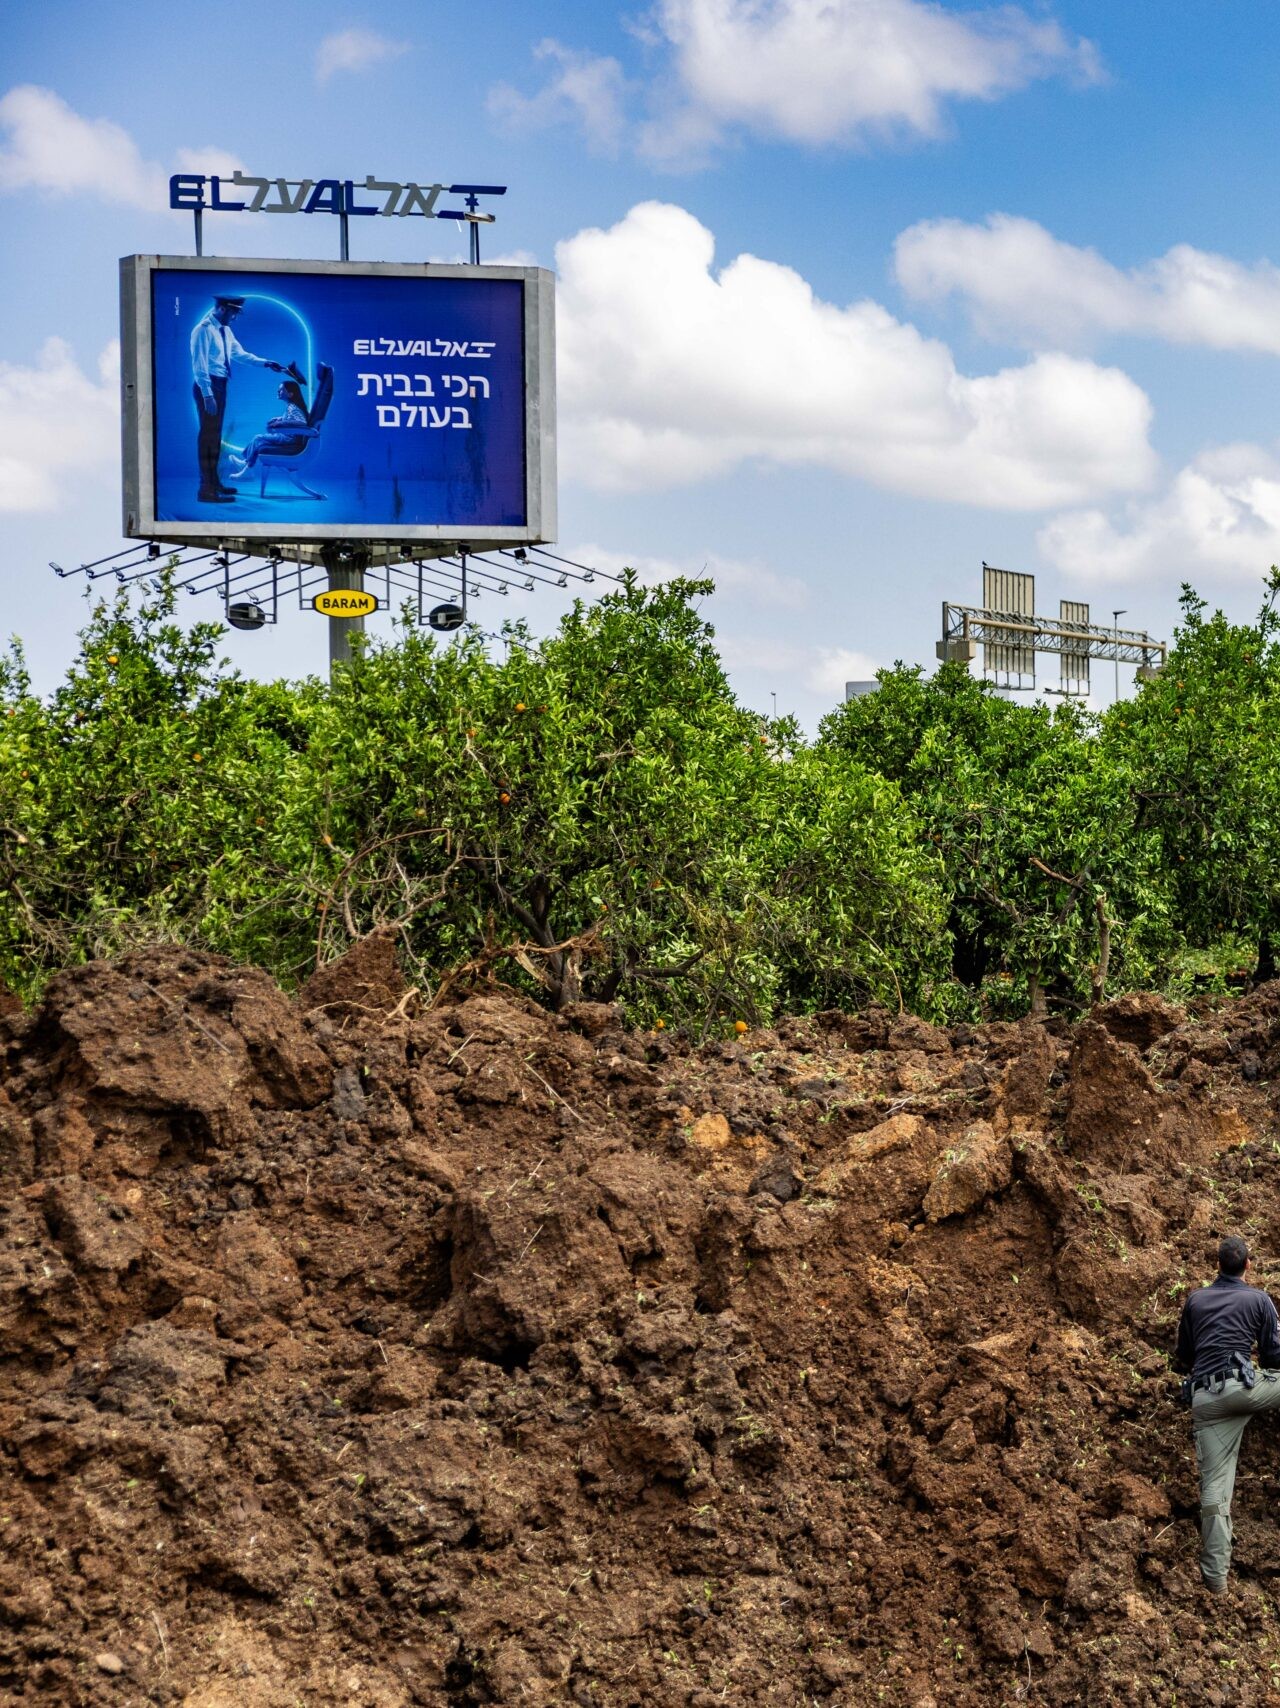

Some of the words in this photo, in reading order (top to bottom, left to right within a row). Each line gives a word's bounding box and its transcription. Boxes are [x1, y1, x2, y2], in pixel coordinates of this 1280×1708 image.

[356, 373, 435, 397] בבית
[441, 374, 490, 398] הכי
[376, 402, 473, 429] בעולם
[322, 598, 369, 609] BARAM
